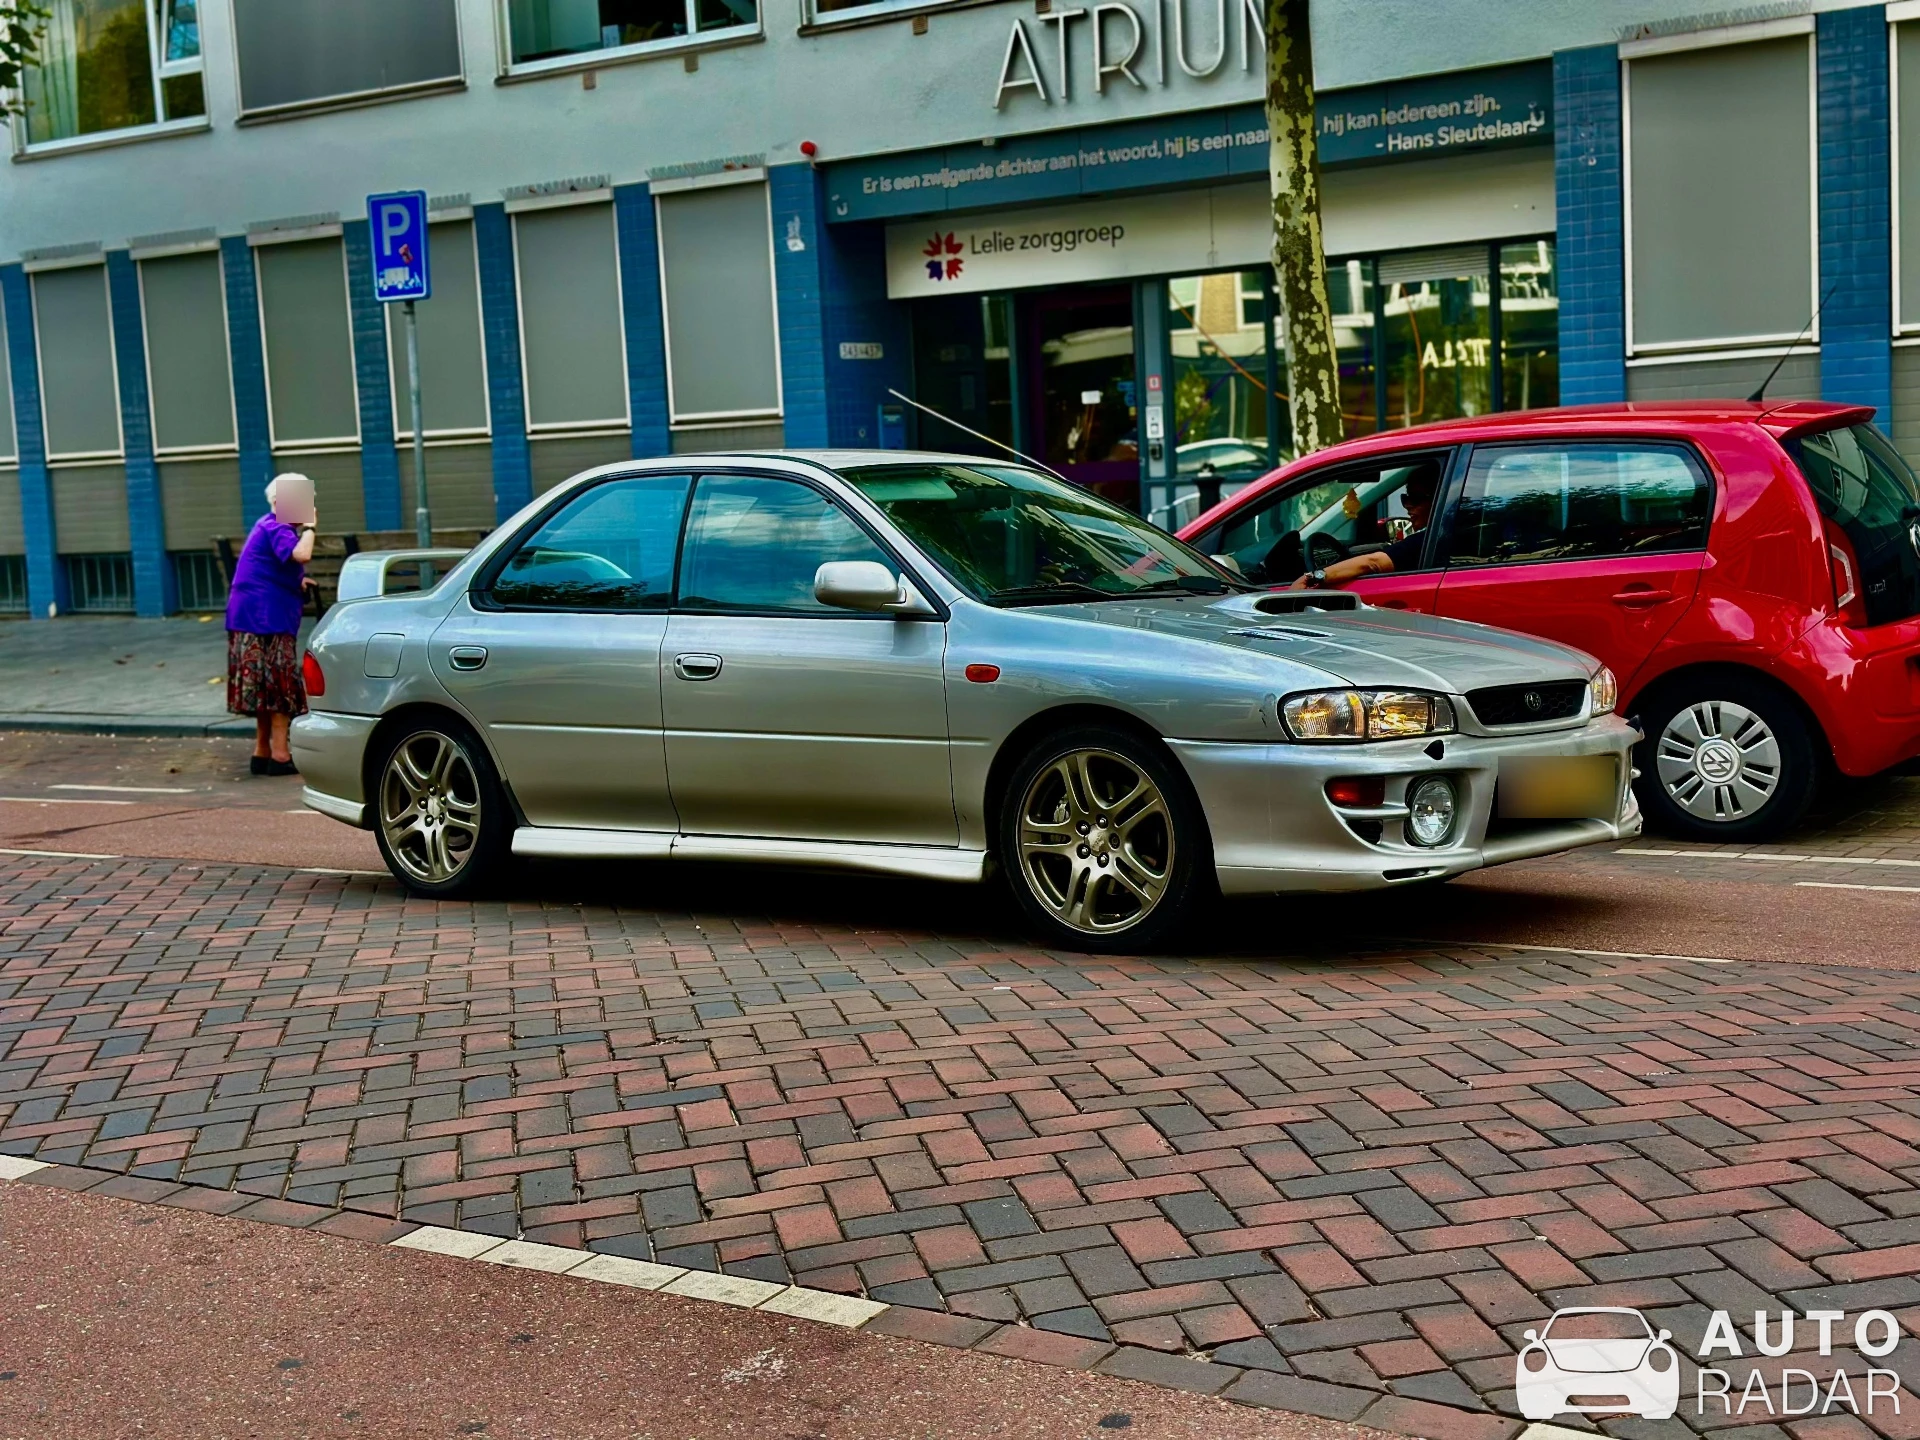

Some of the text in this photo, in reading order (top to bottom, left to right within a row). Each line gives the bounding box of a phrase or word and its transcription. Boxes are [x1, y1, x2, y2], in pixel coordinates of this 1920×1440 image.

[863, 177, 879, 194] Er
[880, 175, 893, 192] is
[893, 175, 921, 190] een
[921, 162, 995, 188] zwijgende
[995, 157, 1048, 178] dichter
[1049, 154, 1077, 171] aan
[1079, 147, 1106, 167] het
[1107, 139, 1163, 163] woord,
[1164, 136, 1184, 158] hij
[1186, 135, 1200, 153] is
[1202, 133, 1233, 151] een
[1323, 113, 1344, 137] hij
[1346, 111, 1378, 131] kan
[1380, 101, 1461, 126] iedereen
[1463, 93, 1501, 117] zijn.
[1387, 132, 1434, 152] Hans
[381, 203, 411, 256] P
[970, 224, 1125, 255] Lelie zorggroep
